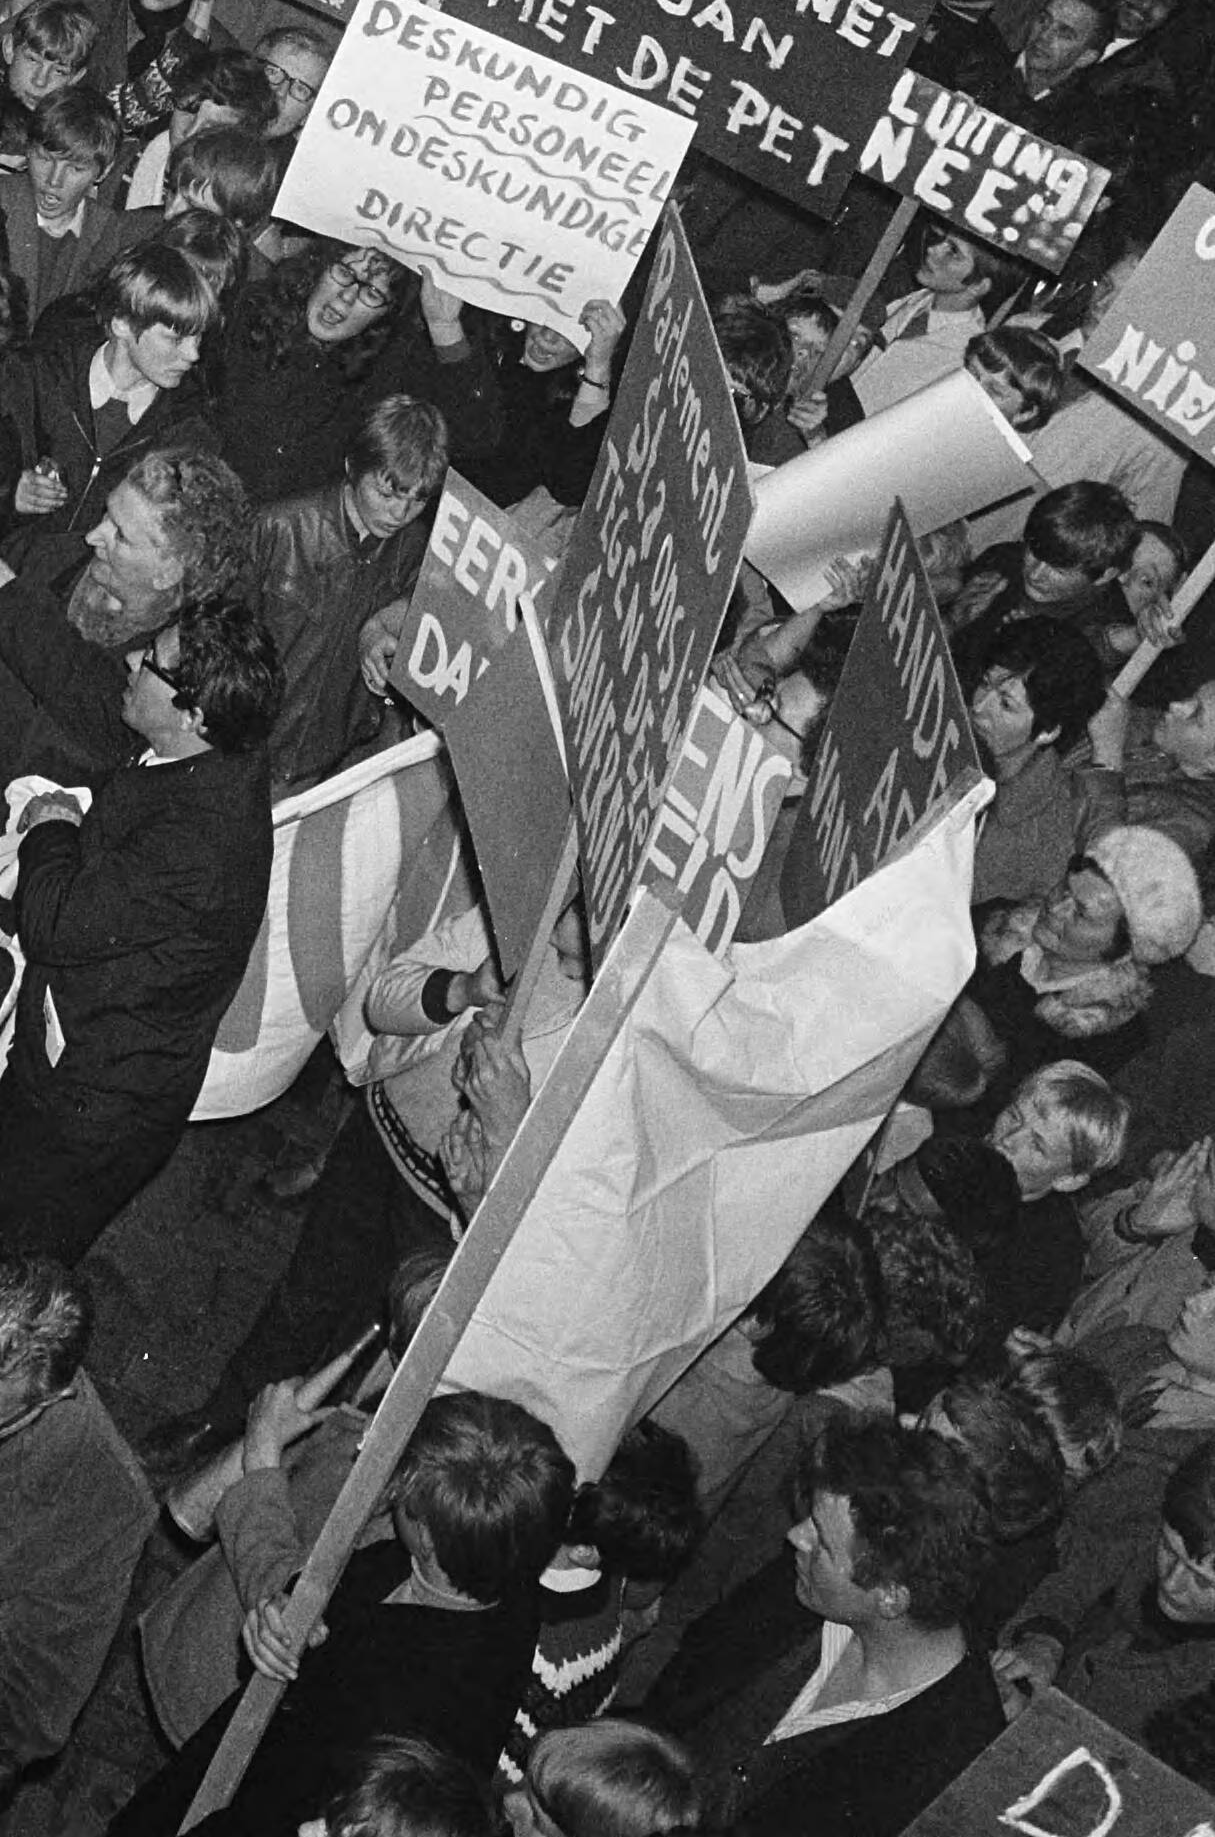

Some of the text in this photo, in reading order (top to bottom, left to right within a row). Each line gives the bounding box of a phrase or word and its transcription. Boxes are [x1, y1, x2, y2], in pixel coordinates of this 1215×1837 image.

[326, 96, 653, 259] ONDESKUNDIGE
[421, 74, 672, 204] PERSONEEL
[614, 33, 714, 117] DE
[724, 78, 851, 188] PET
[356, 187, 577, 295] DIRECTIE
[876, 517, 961, 812] HANDE
